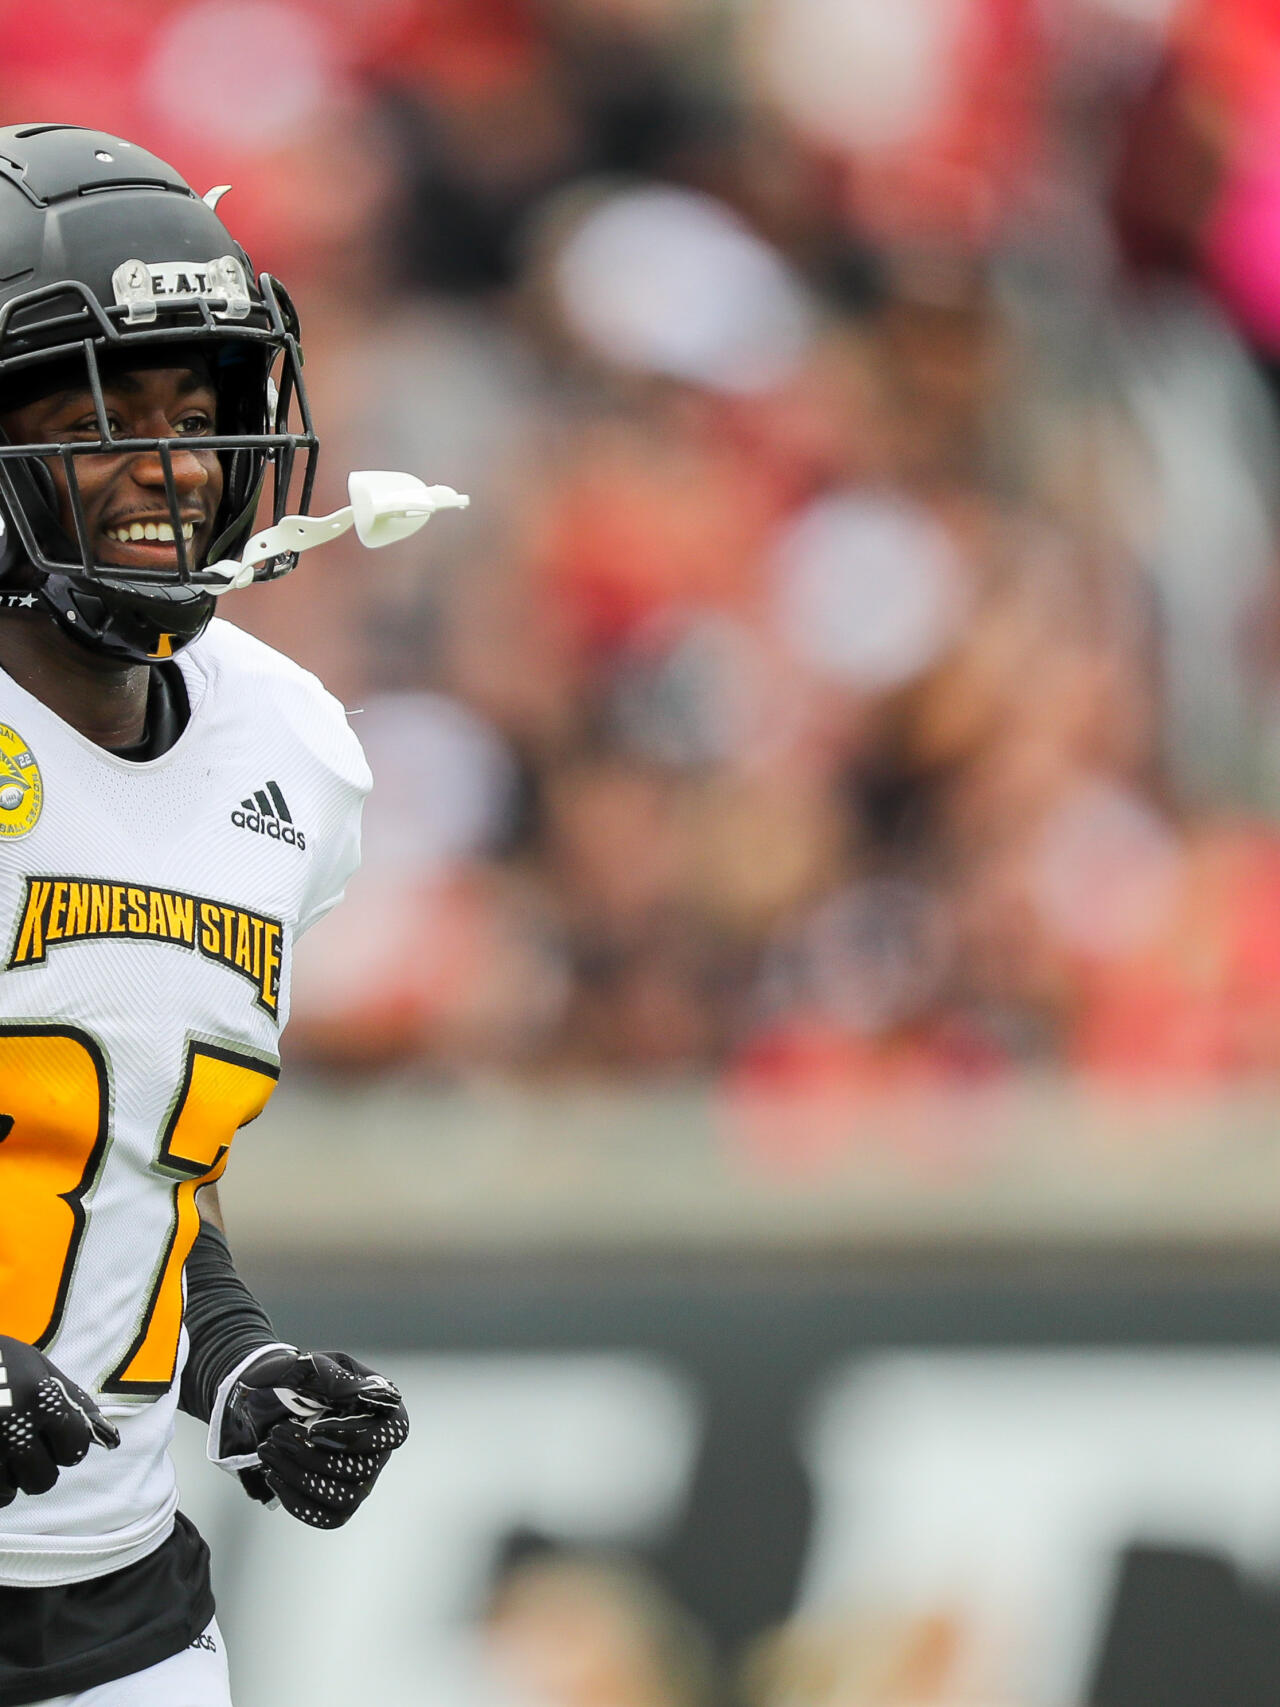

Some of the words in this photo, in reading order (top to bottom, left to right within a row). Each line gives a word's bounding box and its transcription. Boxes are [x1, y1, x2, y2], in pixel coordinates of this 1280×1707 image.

[151, 273, 213, 296] E.A.T.
[18, 753, 33, 767] 22
[25, 773, 41, 825] SEASON
[231, 810, 306, 851] adidas
[9, 878, 195, 967] KENNESAW
[199, 900, 283, 1014] STATE
